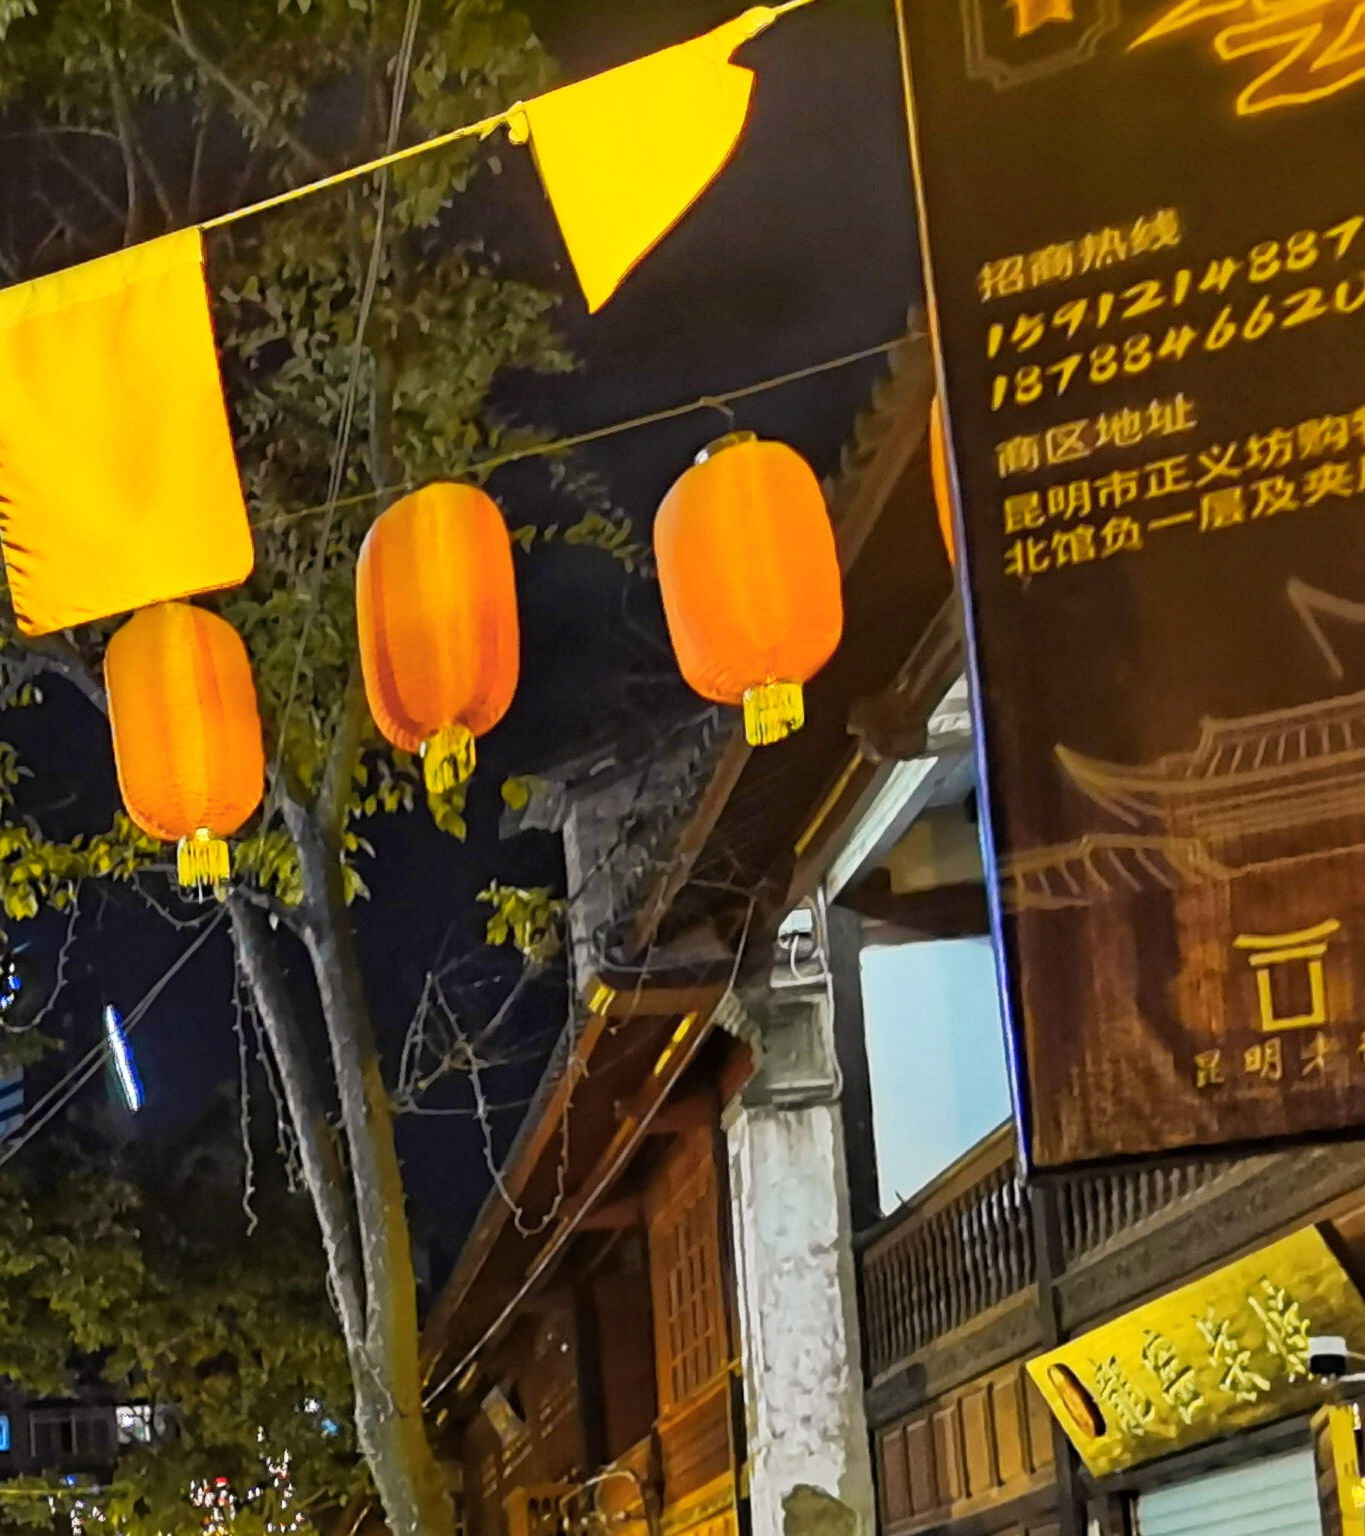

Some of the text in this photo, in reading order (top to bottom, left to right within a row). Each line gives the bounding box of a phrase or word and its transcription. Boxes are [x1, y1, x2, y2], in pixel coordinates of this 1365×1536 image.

[977, 207, 1182, 300] 招商热线
[996, 393, 1197, 478] 商区地址
[1003, 405, 1365, 535] 昆明市正义坊购
[1004, 454, 1365, 578] 北馆负一层及夹
